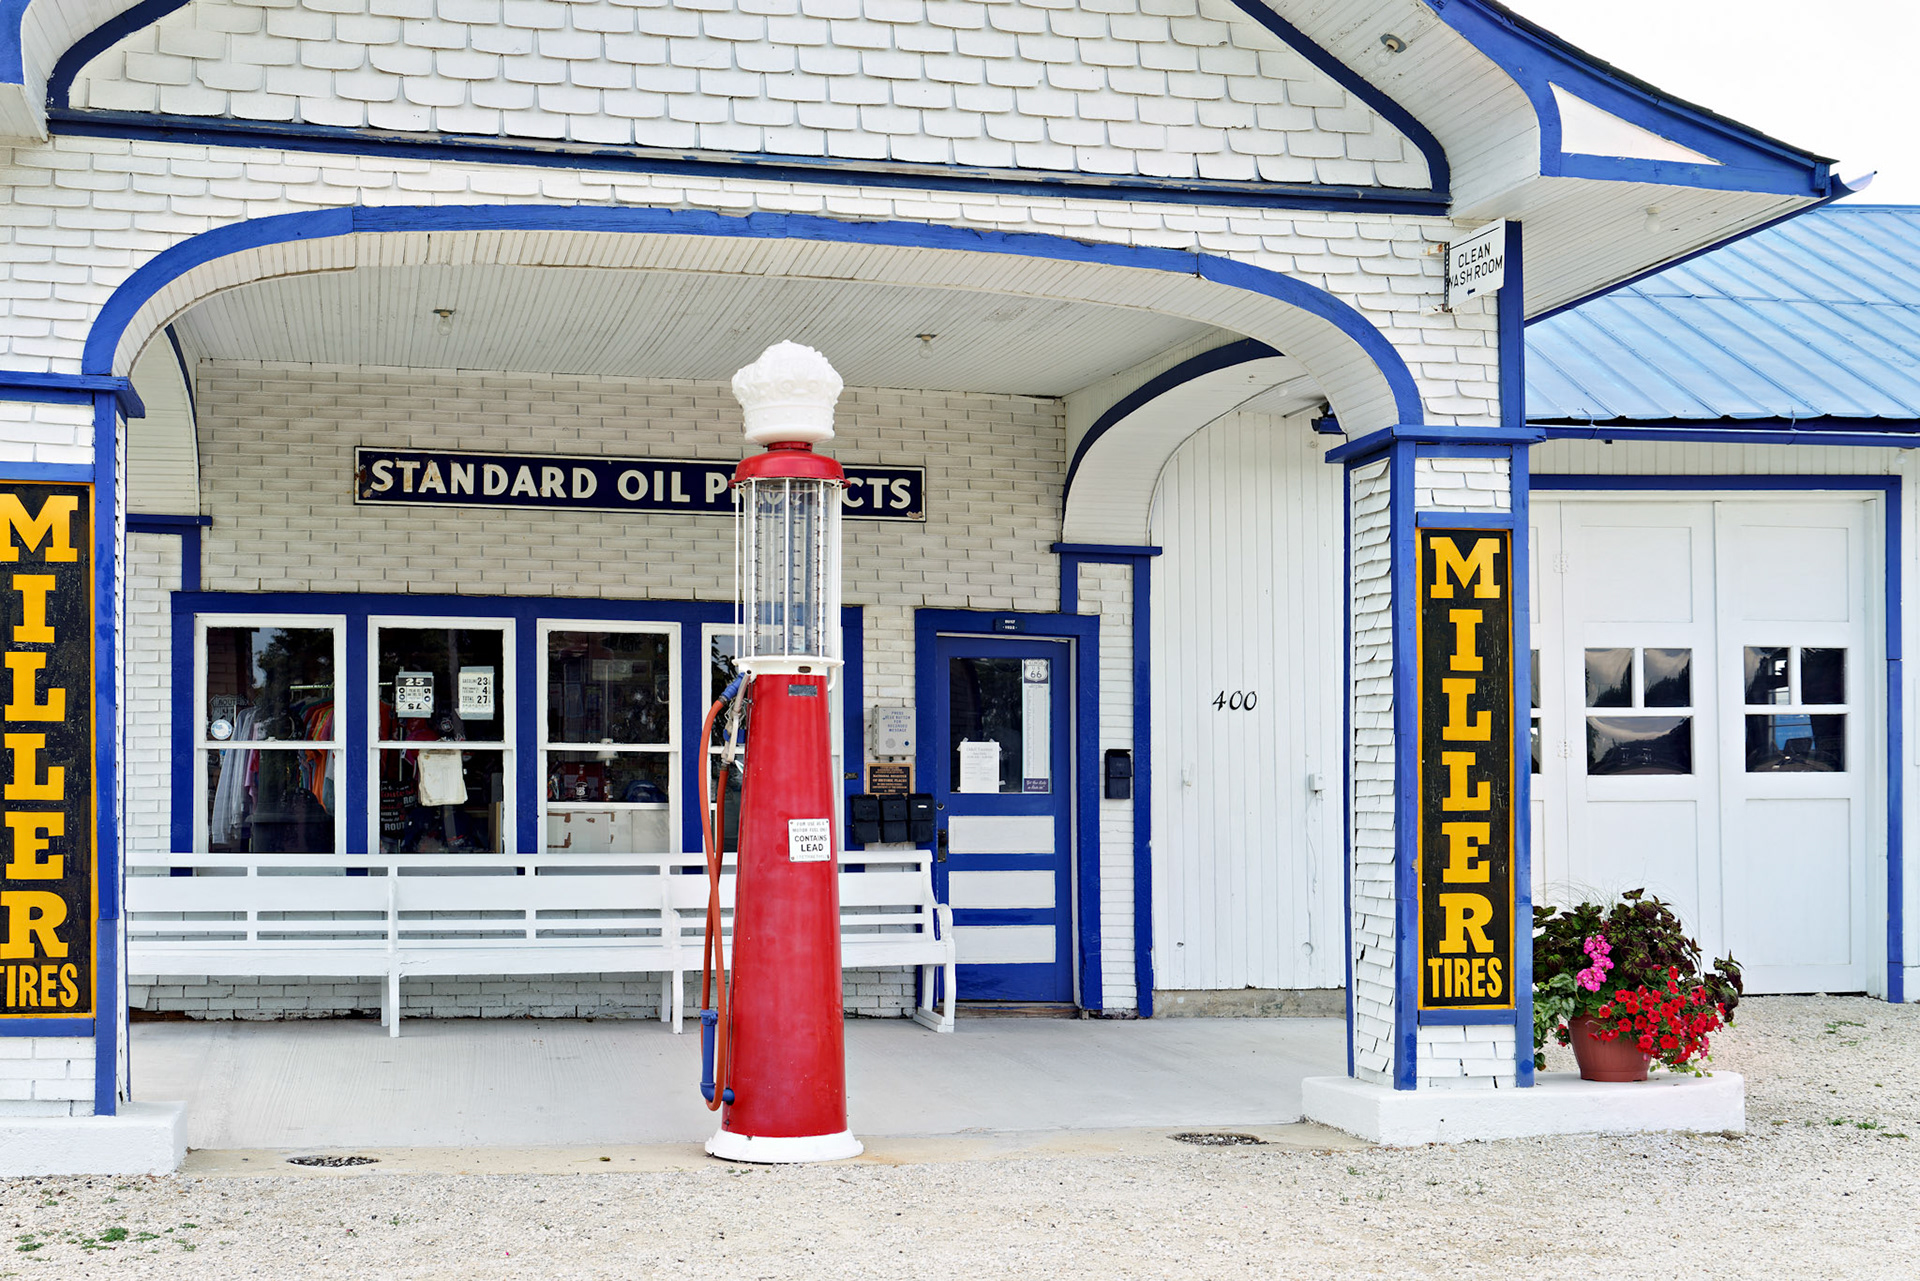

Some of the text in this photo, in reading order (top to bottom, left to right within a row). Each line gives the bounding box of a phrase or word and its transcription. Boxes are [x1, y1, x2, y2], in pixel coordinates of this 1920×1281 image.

[1458, 242, 1491, 268] CLEAN
[371, 459, 912, 510] STANDARD OIL PCTS
[405, 678, 425, 686] 25
[477, 677, 488, 685] 23
[1030, 671, 1042, 679] 66
[477, 695, 488, 704] 27
[482, 686, 488, 695] 4
[1212, 690, 1257, 711] 400
[0, 494, 79, 959] MILLER
[1430, 537, 1500, 954] MILLER
[801, 843, 824, 852] LEAD
[0, 963, 79, 1008] IRES
[1427, 957, 1503, 998] TIRES
